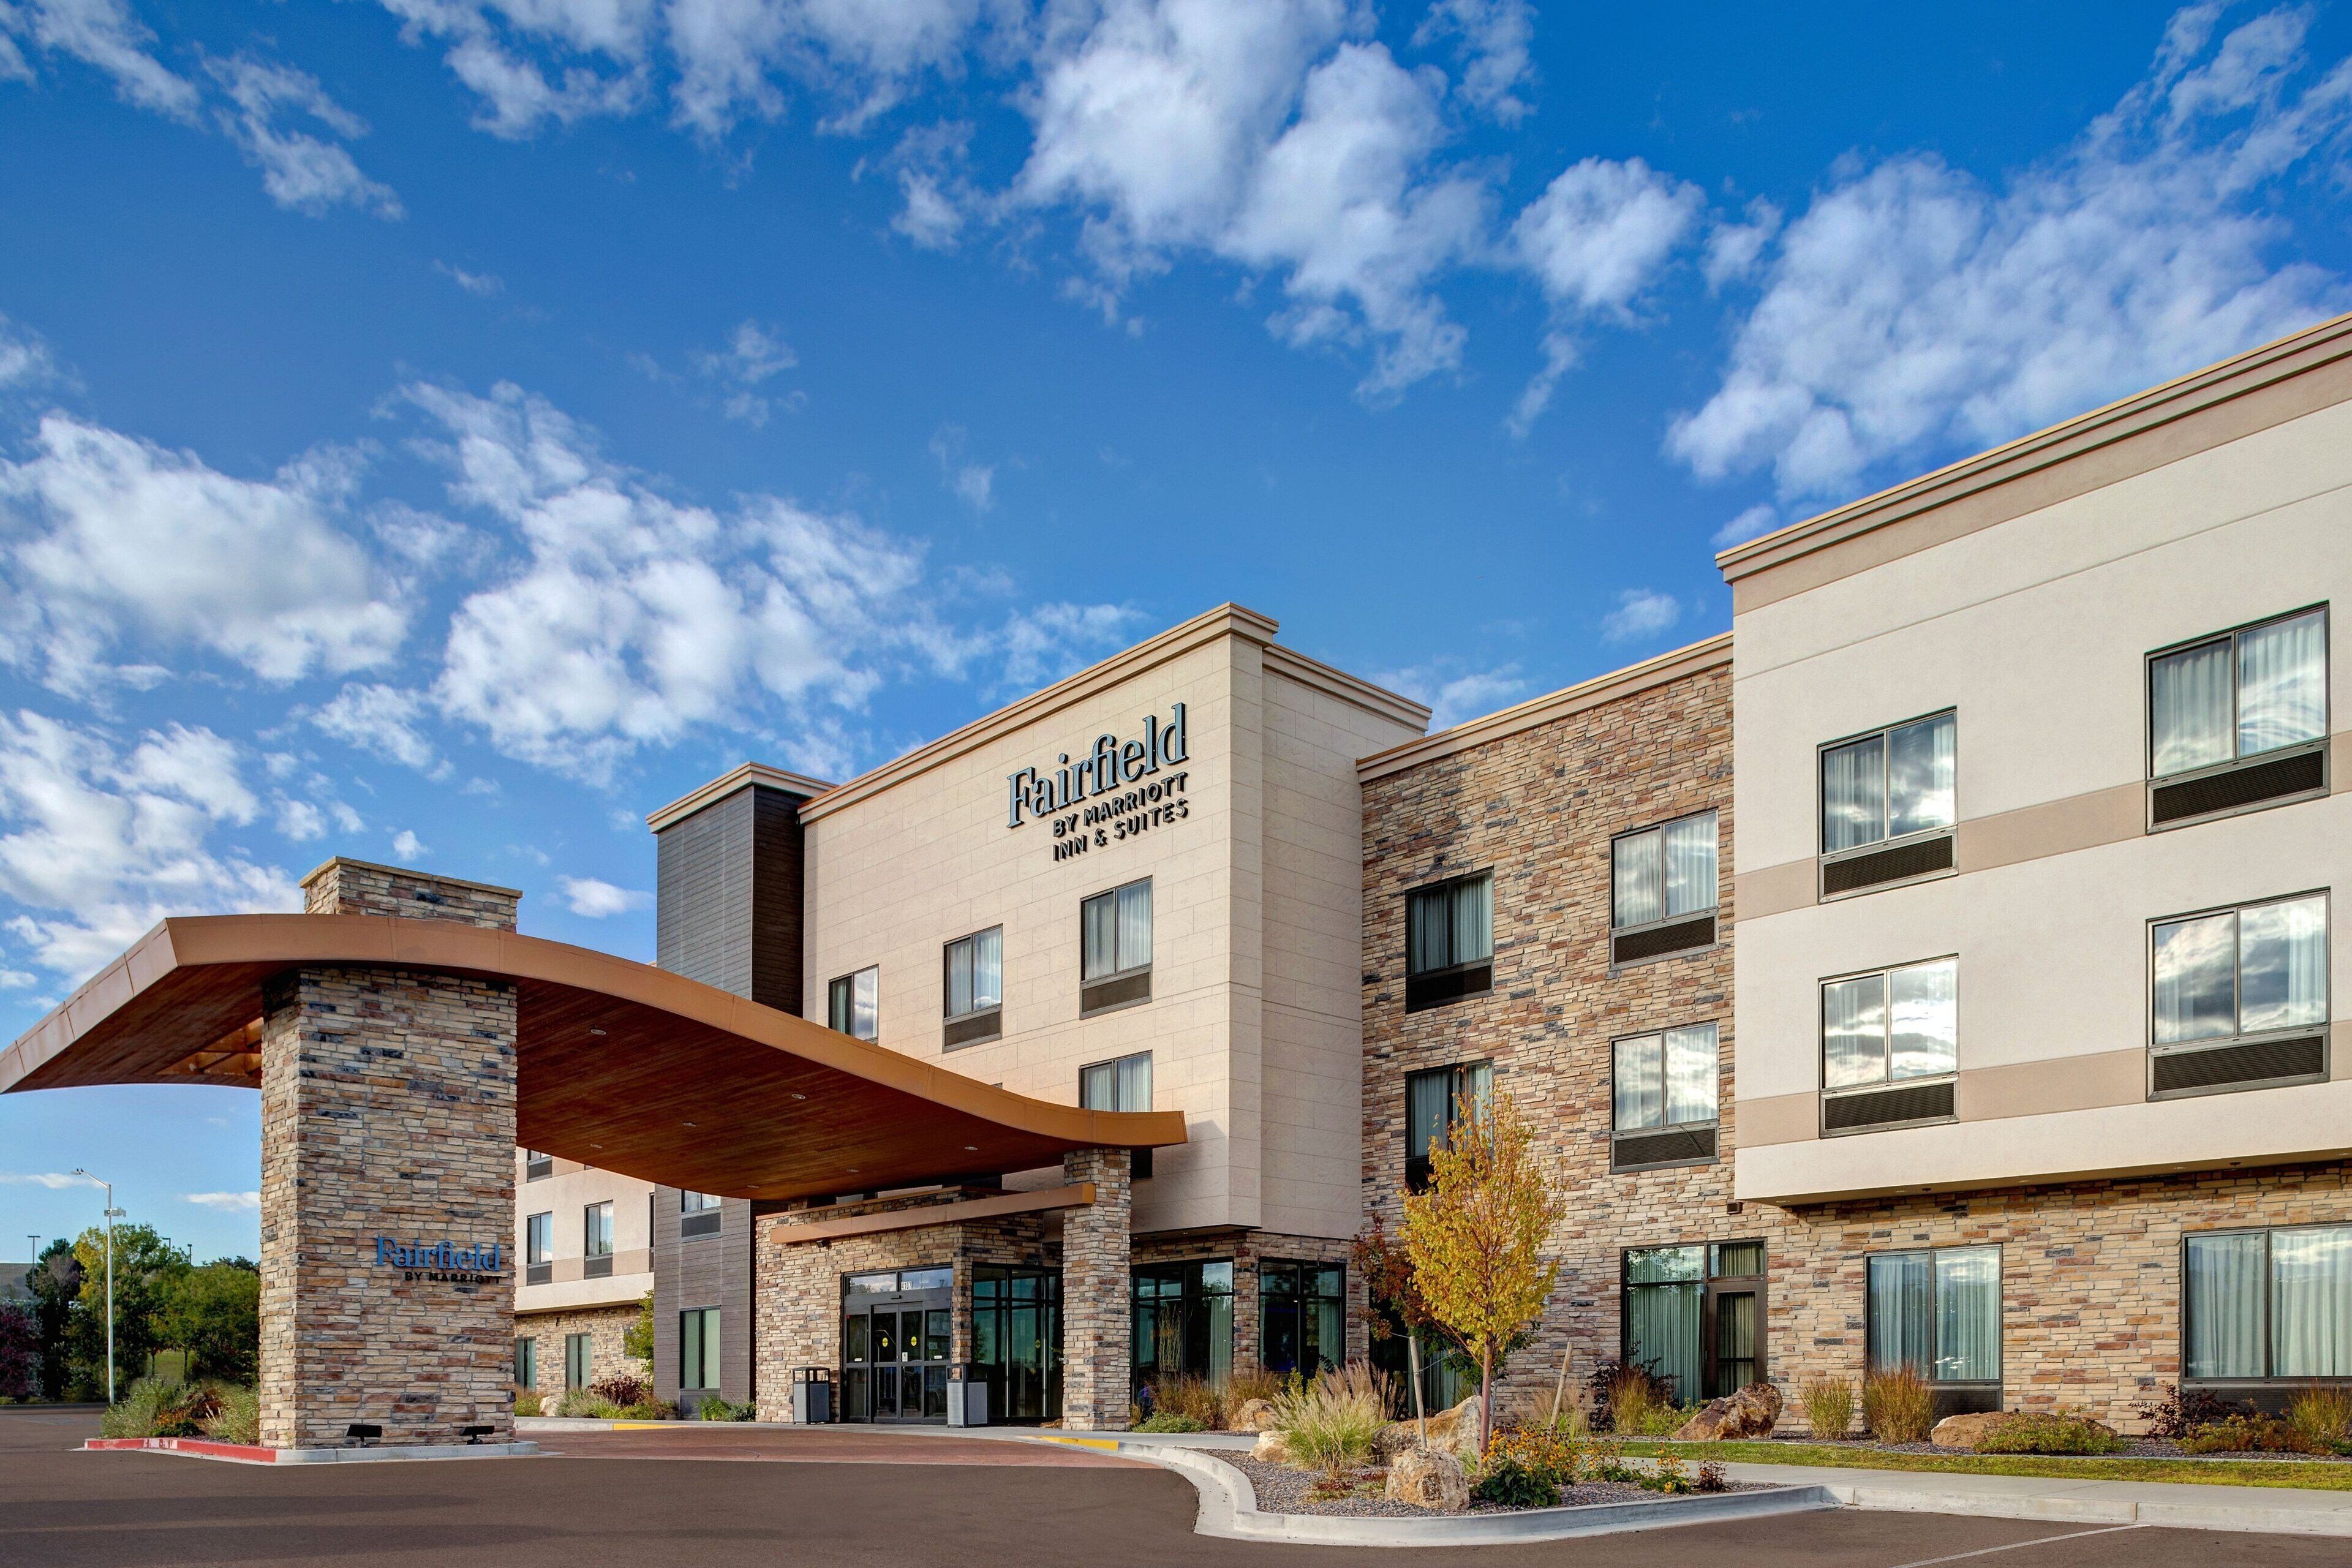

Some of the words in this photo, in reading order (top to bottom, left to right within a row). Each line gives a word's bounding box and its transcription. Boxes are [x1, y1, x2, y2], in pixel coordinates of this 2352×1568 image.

[1006, 702, 1189, 828] Fairfield
[1053, 813, 1078, 837] BY
[1083, 772, 1188, 826] MARRIOTT
[1053, 834, 1087, 862] INN
[1094, 828, 1107, 846] &
[1114, 798, 1188, 840] SUITES
[375, 1237, 500, 1272] Fairfield
[405, 1272, 423, 1281] BY
[429, 1273, 502, 1284] MARRIOTT
